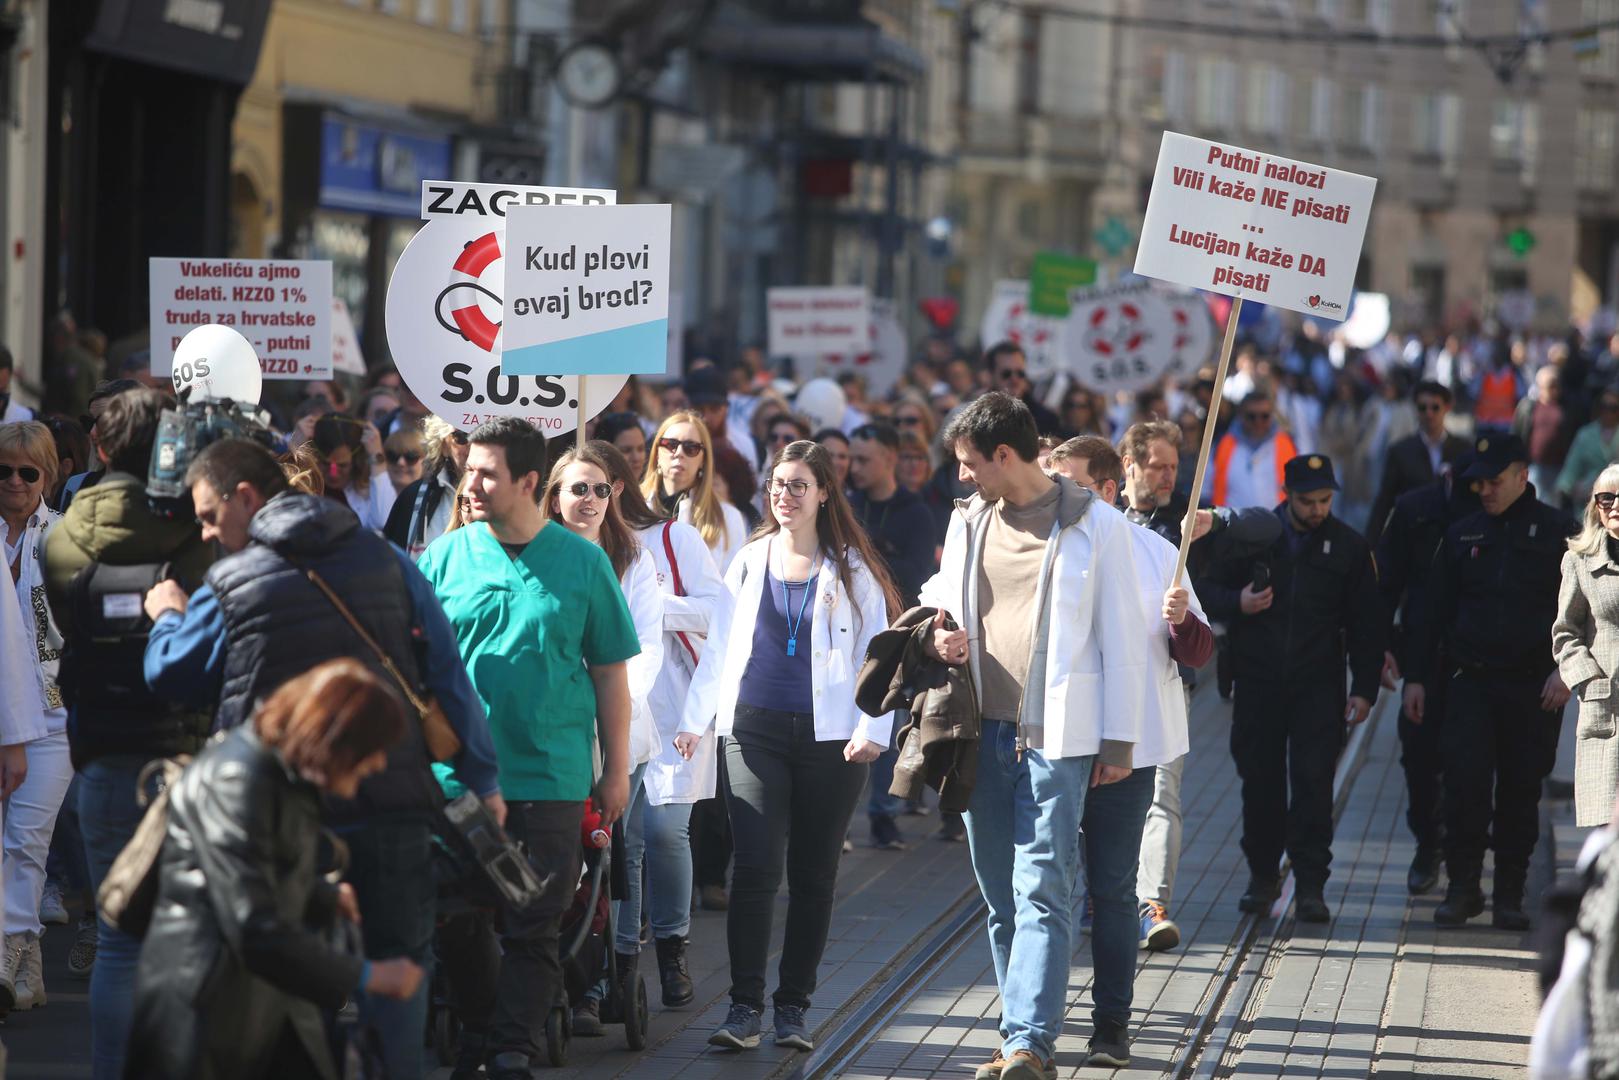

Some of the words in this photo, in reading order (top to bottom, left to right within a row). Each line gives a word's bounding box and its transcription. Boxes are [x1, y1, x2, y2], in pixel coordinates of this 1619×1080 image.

[1207, 146, 1261, 175] Putni
[1264, 163, 1327, 190] nalozi
[1173, 166, 1205, 191] Vili
[1208, 175, 1256, 202] kaže
[1261, 187, 1289, 210] NE
[1291, 197, 1351, 224] pisati
[525, 244, 576, 271] Kud
[584, 244, 649, 277] plovi
[1169, 224, 1241, 256] Lucijan
[1245, 242, 1294, 269] kaže
[1298, 254, 1326, 277] DA
[180, 261, 253, 278] Vukeliću
[258, 264, 300, 281] ajmo
[1212, 266, 1271, 293] pisati
[174, 286, 227, 301] delati.
[232, 287, 275, 302] HZZO
[281, 287, 307, 303] 1%
[513, 287, 569, 319] ovaj
[578, 280, 653, 311] brod?
[166, 309, 211, 325] truda
[217, 313, 236, 325] za
[241, 311, 316, 326] hrvatske
[267, 335, 310, 351] putni
[173, 358, 210, 388] SOS
[440, 362, 578, 409] S.O.S.
[462, 413, 479, 425] ZA
